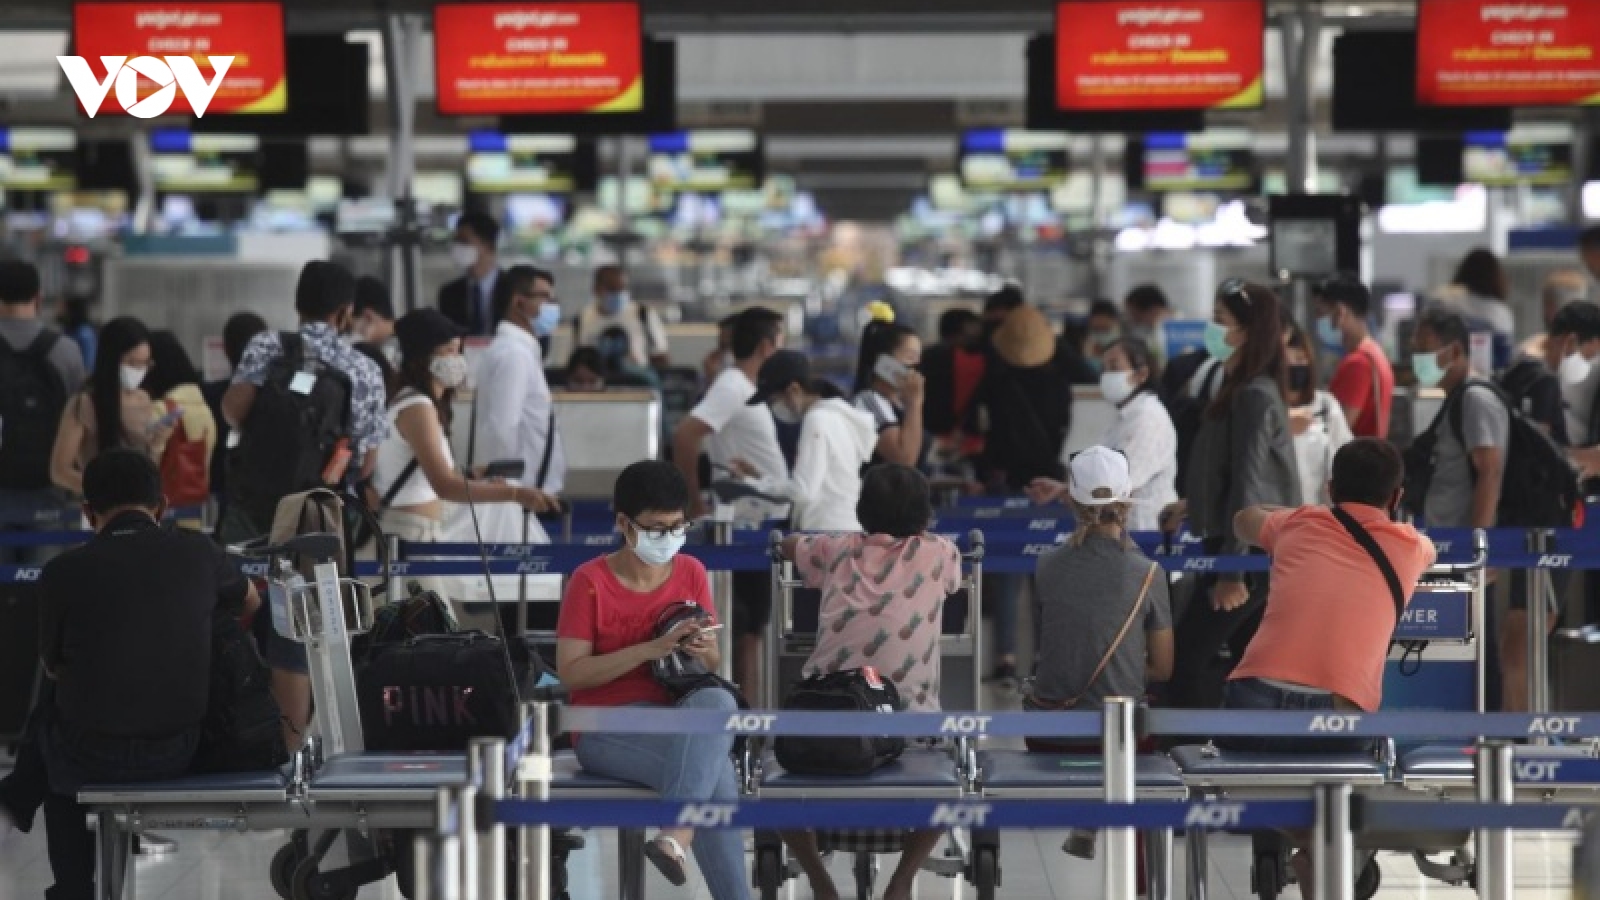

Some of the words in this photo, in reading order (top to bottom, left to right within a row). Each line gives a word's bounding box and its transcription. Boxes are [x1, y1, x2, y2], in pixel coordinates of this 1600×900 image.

[1183, 557, 1217, 570] AOT
[1538, 555, 1573, 567] AOT
[15, 567, 42, 581] AOT
[383, 685, 477, 726] PINK
[725, 713, 777, 731] AOT
[941, 715, 992, 733] AOT
[1308, 715, 1362, 733] AOT
[1527, 717, 1581, 733] AOT
[677, 804, 739, 826] AOT
[929, 803, 993, 827] AOT
[1184, 803, 1246, 827] AOT
